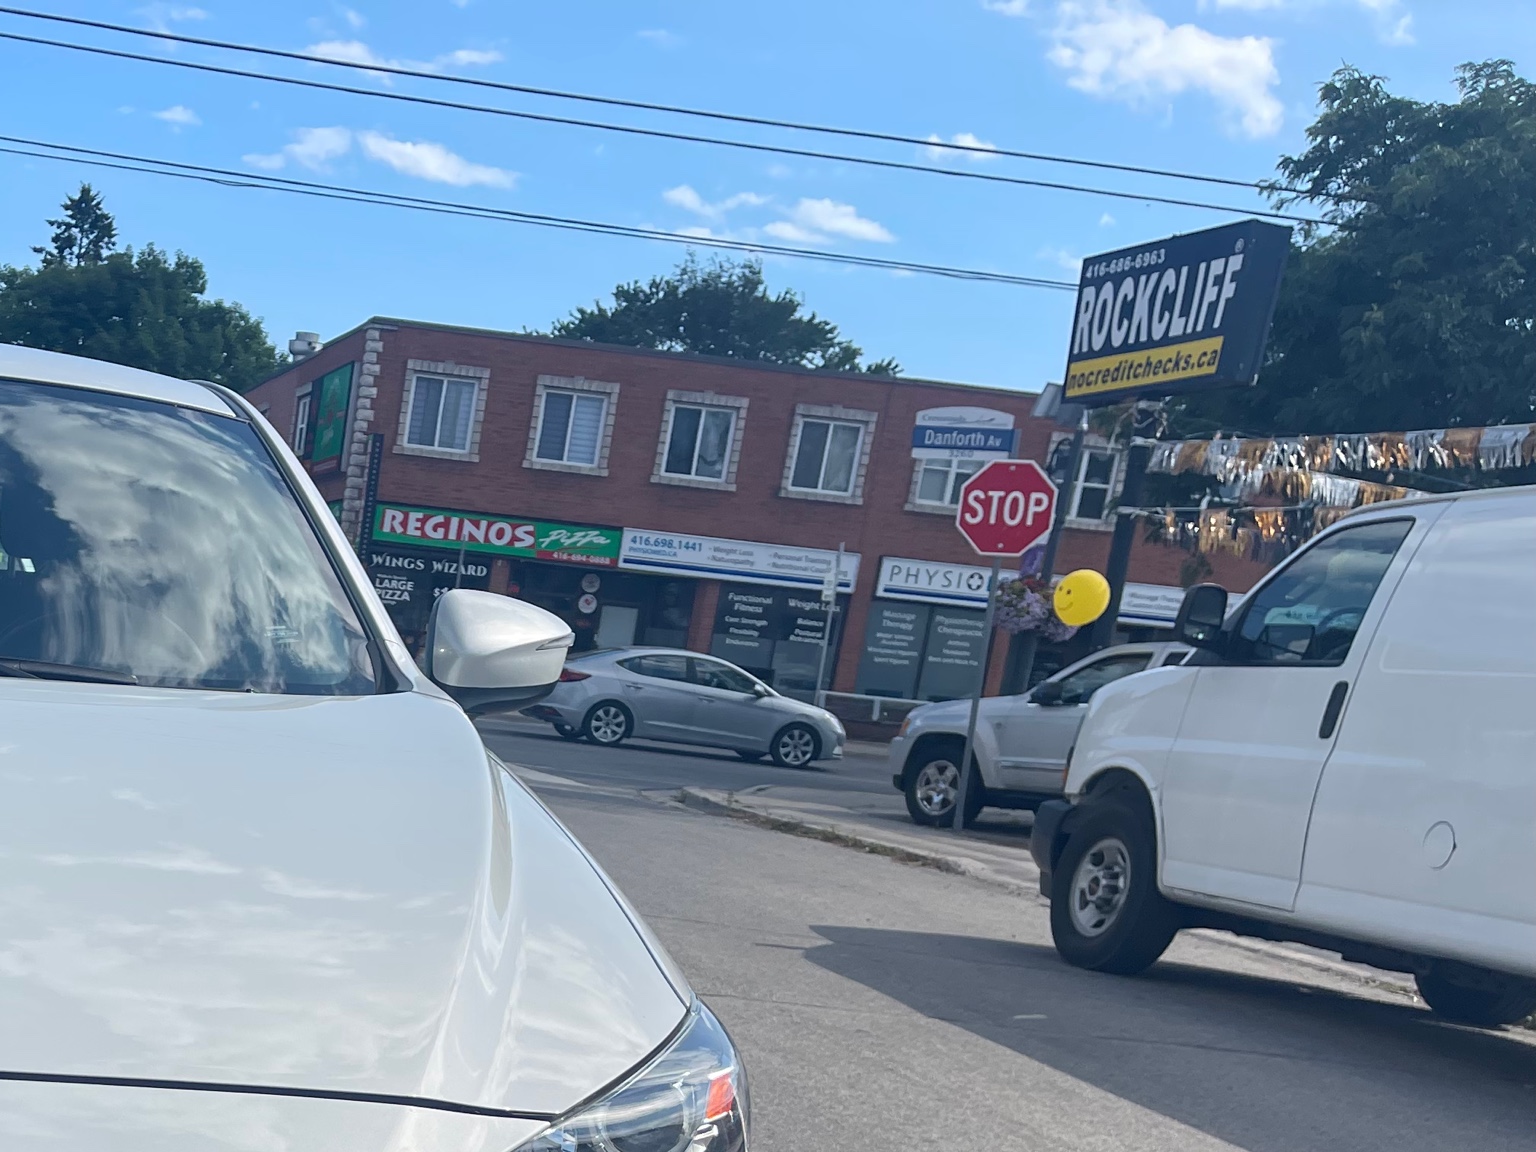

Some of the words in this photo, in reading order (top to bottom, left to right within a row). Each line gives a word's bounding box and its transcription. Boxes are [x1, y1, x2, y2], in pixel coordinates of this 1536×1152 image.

[1085, 248, 1166, 280] 416-686-6963
[1073, 254, 1244, 355] ROCKCLIFF
[1067, 348, 1219, 390] nocreditchecks.ca
[924, 429, 985, 446] Danforth
[986, 435, 1003, 447] Av
[965, 489, 1049, 526] STOP
[381, 508, 536, 548] REGINOS
[538, 529, 611, 548] Pizza
[630, 535, 703, 553] 416.698.1441
[370, 553, 425, 571] WINGS
[431, 558, 488, 578] WIZARD
[375, 578, 415, 591] LARGE
[375, 589, 411, 602] PIZZA
[788, 598, 820, 611] Weight
